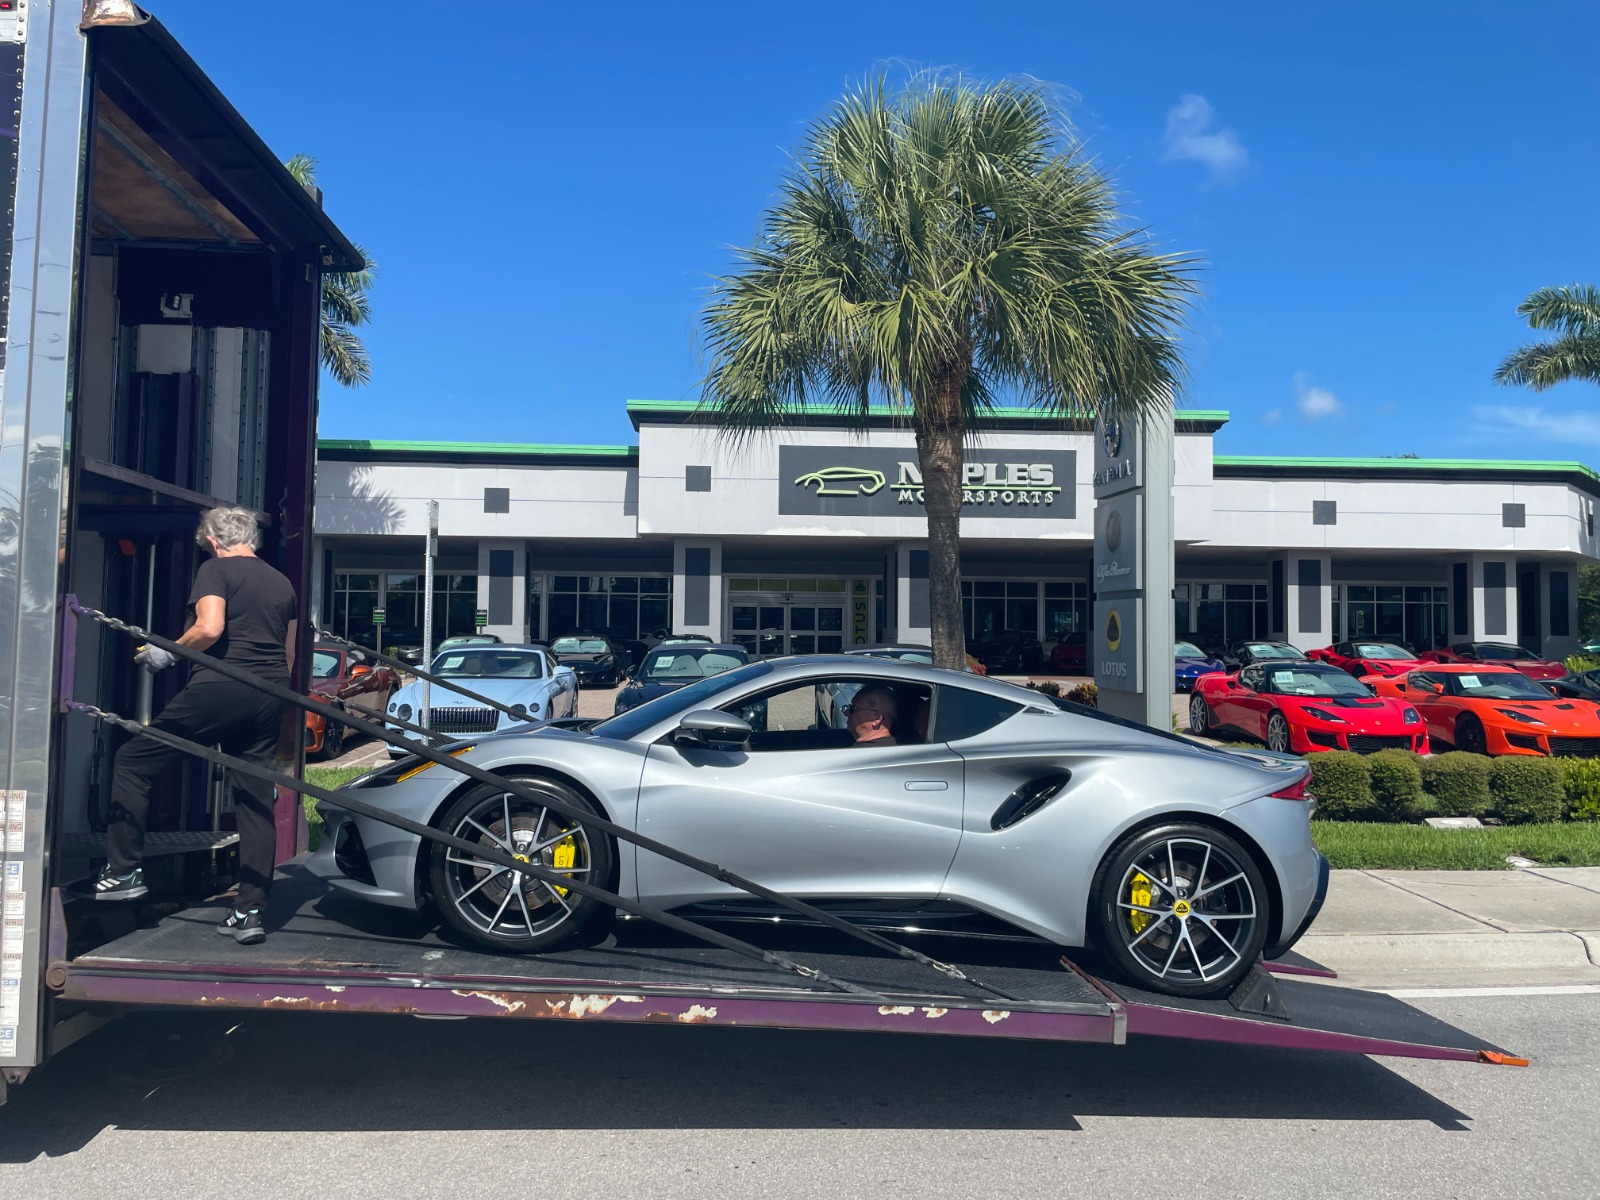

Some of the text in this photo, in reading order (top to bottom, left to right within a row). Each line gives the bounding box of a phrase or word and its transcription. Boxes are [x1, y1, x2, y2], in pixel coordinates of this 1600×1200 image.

[897, 461, 1053, 486] NPLES
[898, 489, 1053, 503] MORSPORTS
[855, 602, 866, 645] OTUS
[1101, 660, 1127, 677] LOTUS
